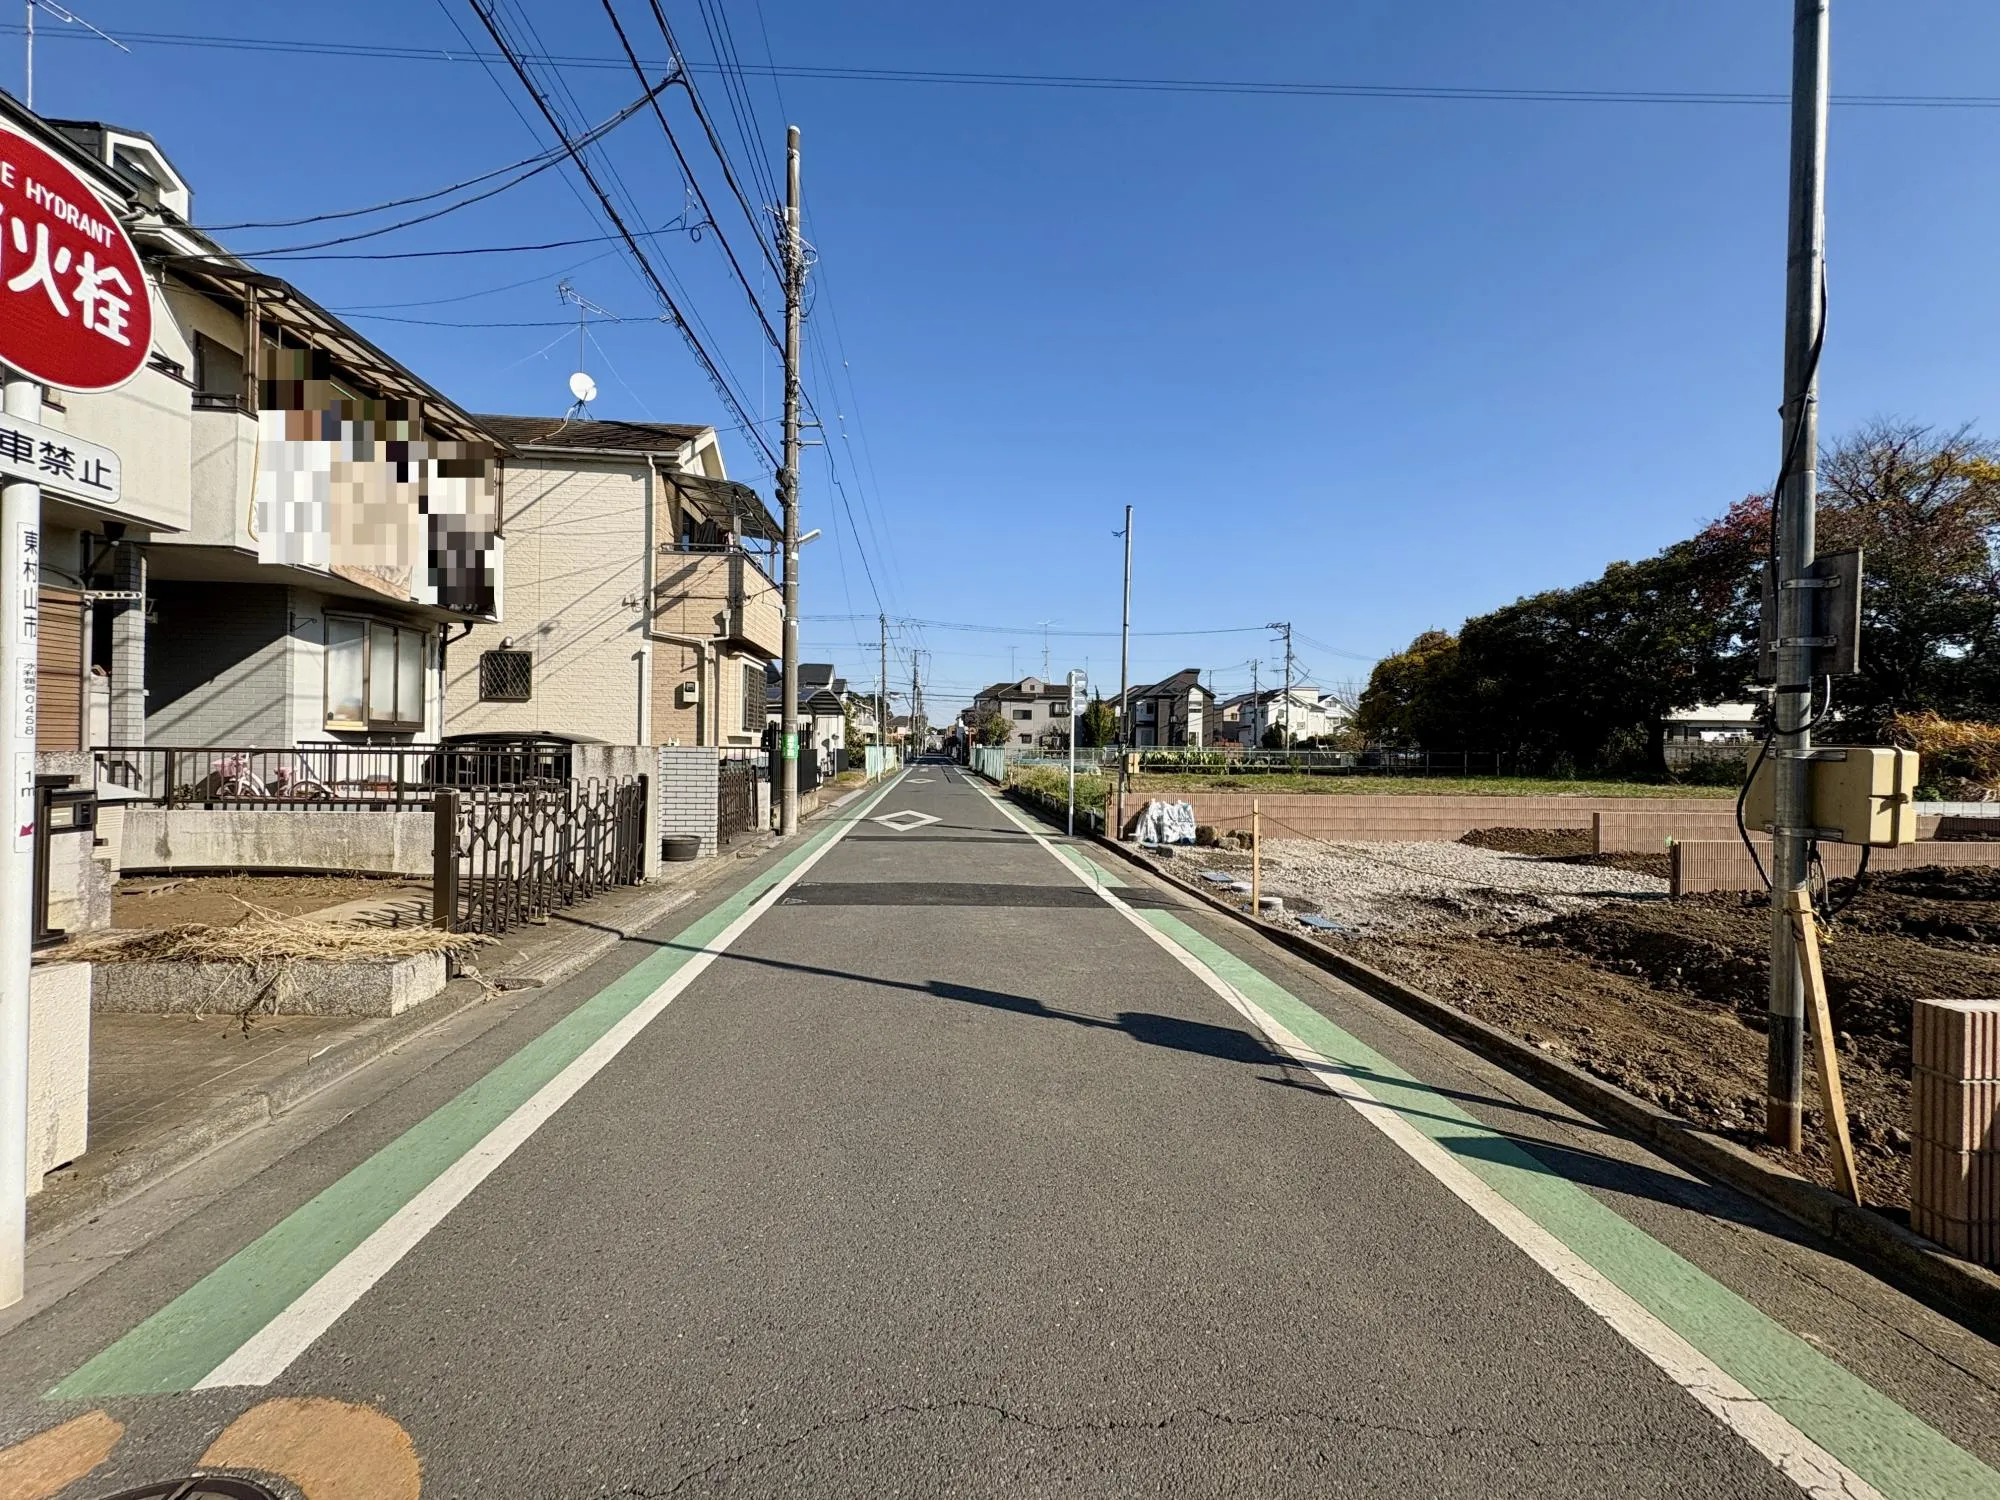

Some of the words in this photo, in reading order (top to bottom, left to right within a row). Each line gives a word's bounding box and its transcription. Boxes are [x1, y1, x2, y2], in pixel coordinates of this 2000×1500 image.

[26, 176, 116, 248] HYDRANT
[0, 203, 132, 346] 火栓
[24, 530, 38, 639] 東村山市
